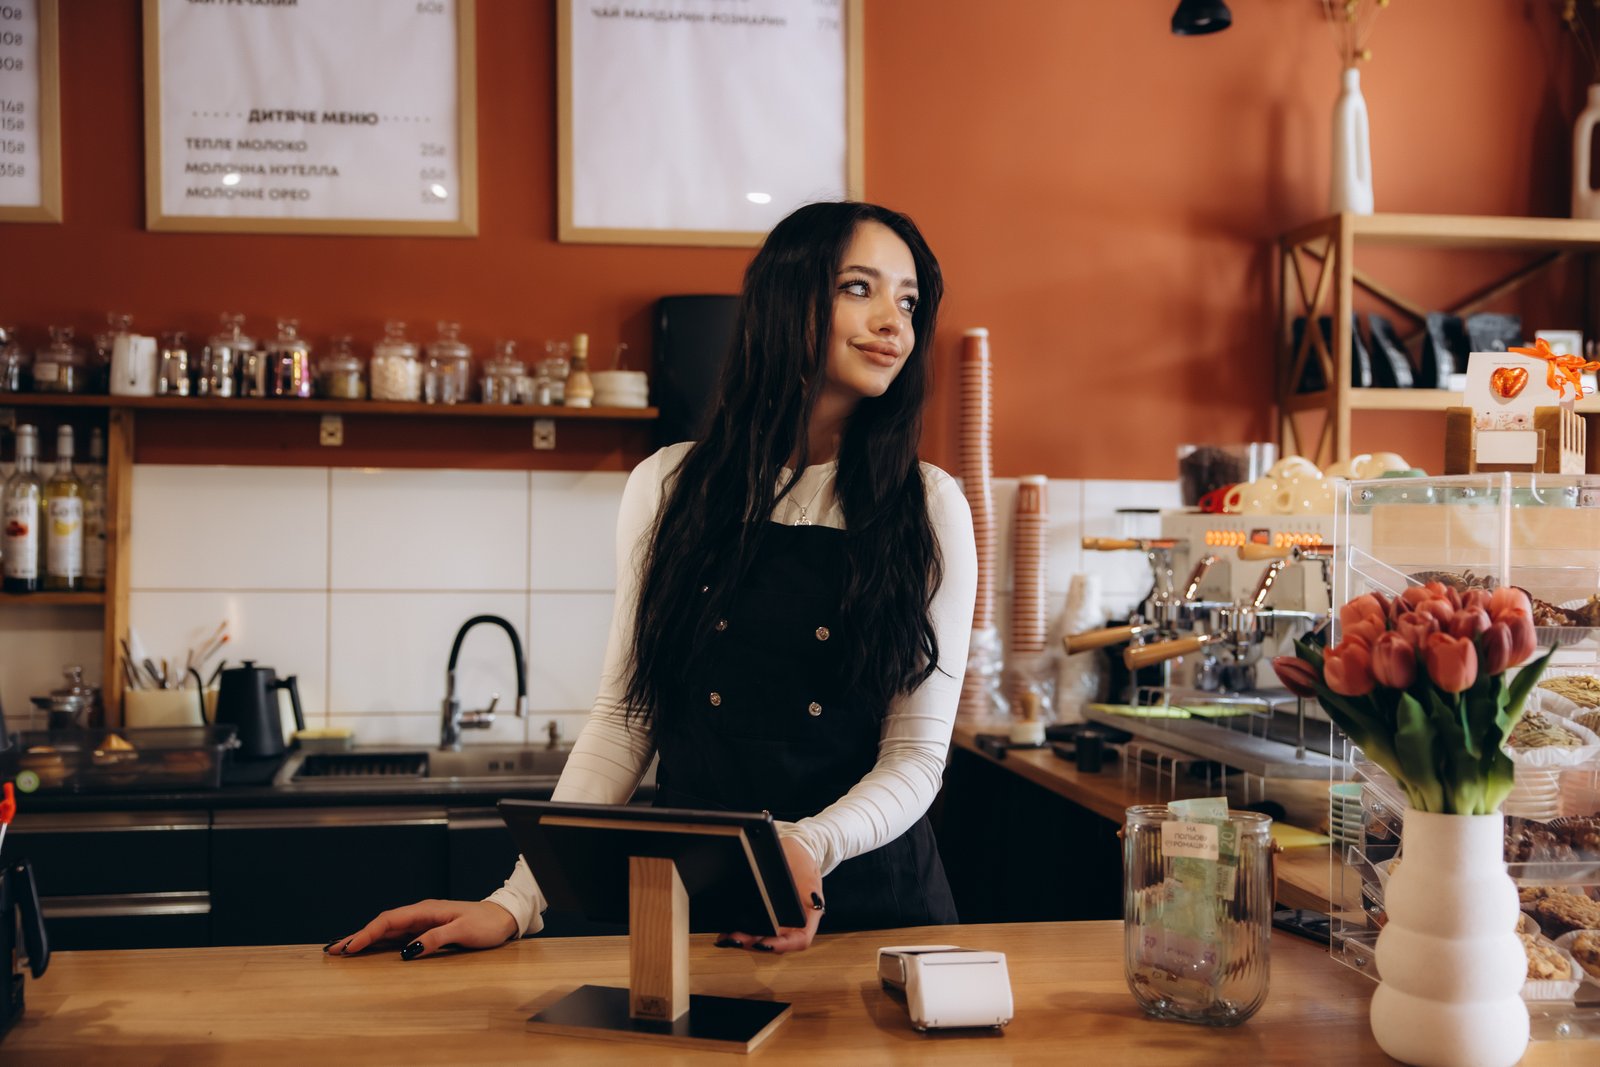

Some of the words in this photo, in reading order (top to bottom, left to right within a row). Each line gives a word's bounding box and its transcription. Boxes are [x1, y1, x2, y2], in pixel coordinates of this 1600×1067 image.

[248, 109, 316, 124] ДИТЯЧЕ
[321, 111, 379, 126] МЕНЮ
[185, 137, 232, 150] ТЕПЛЕ
[237, 139, 307, 152] МОЛОКО
[185, 162, 266, 175] МОЛОЧНА
[269, 165, 339, 177] НУТЕЛЛА
[185, 187, 263, 199] МОЛОЧНЕ
[268, 188, 310, 201] ОРЕО
